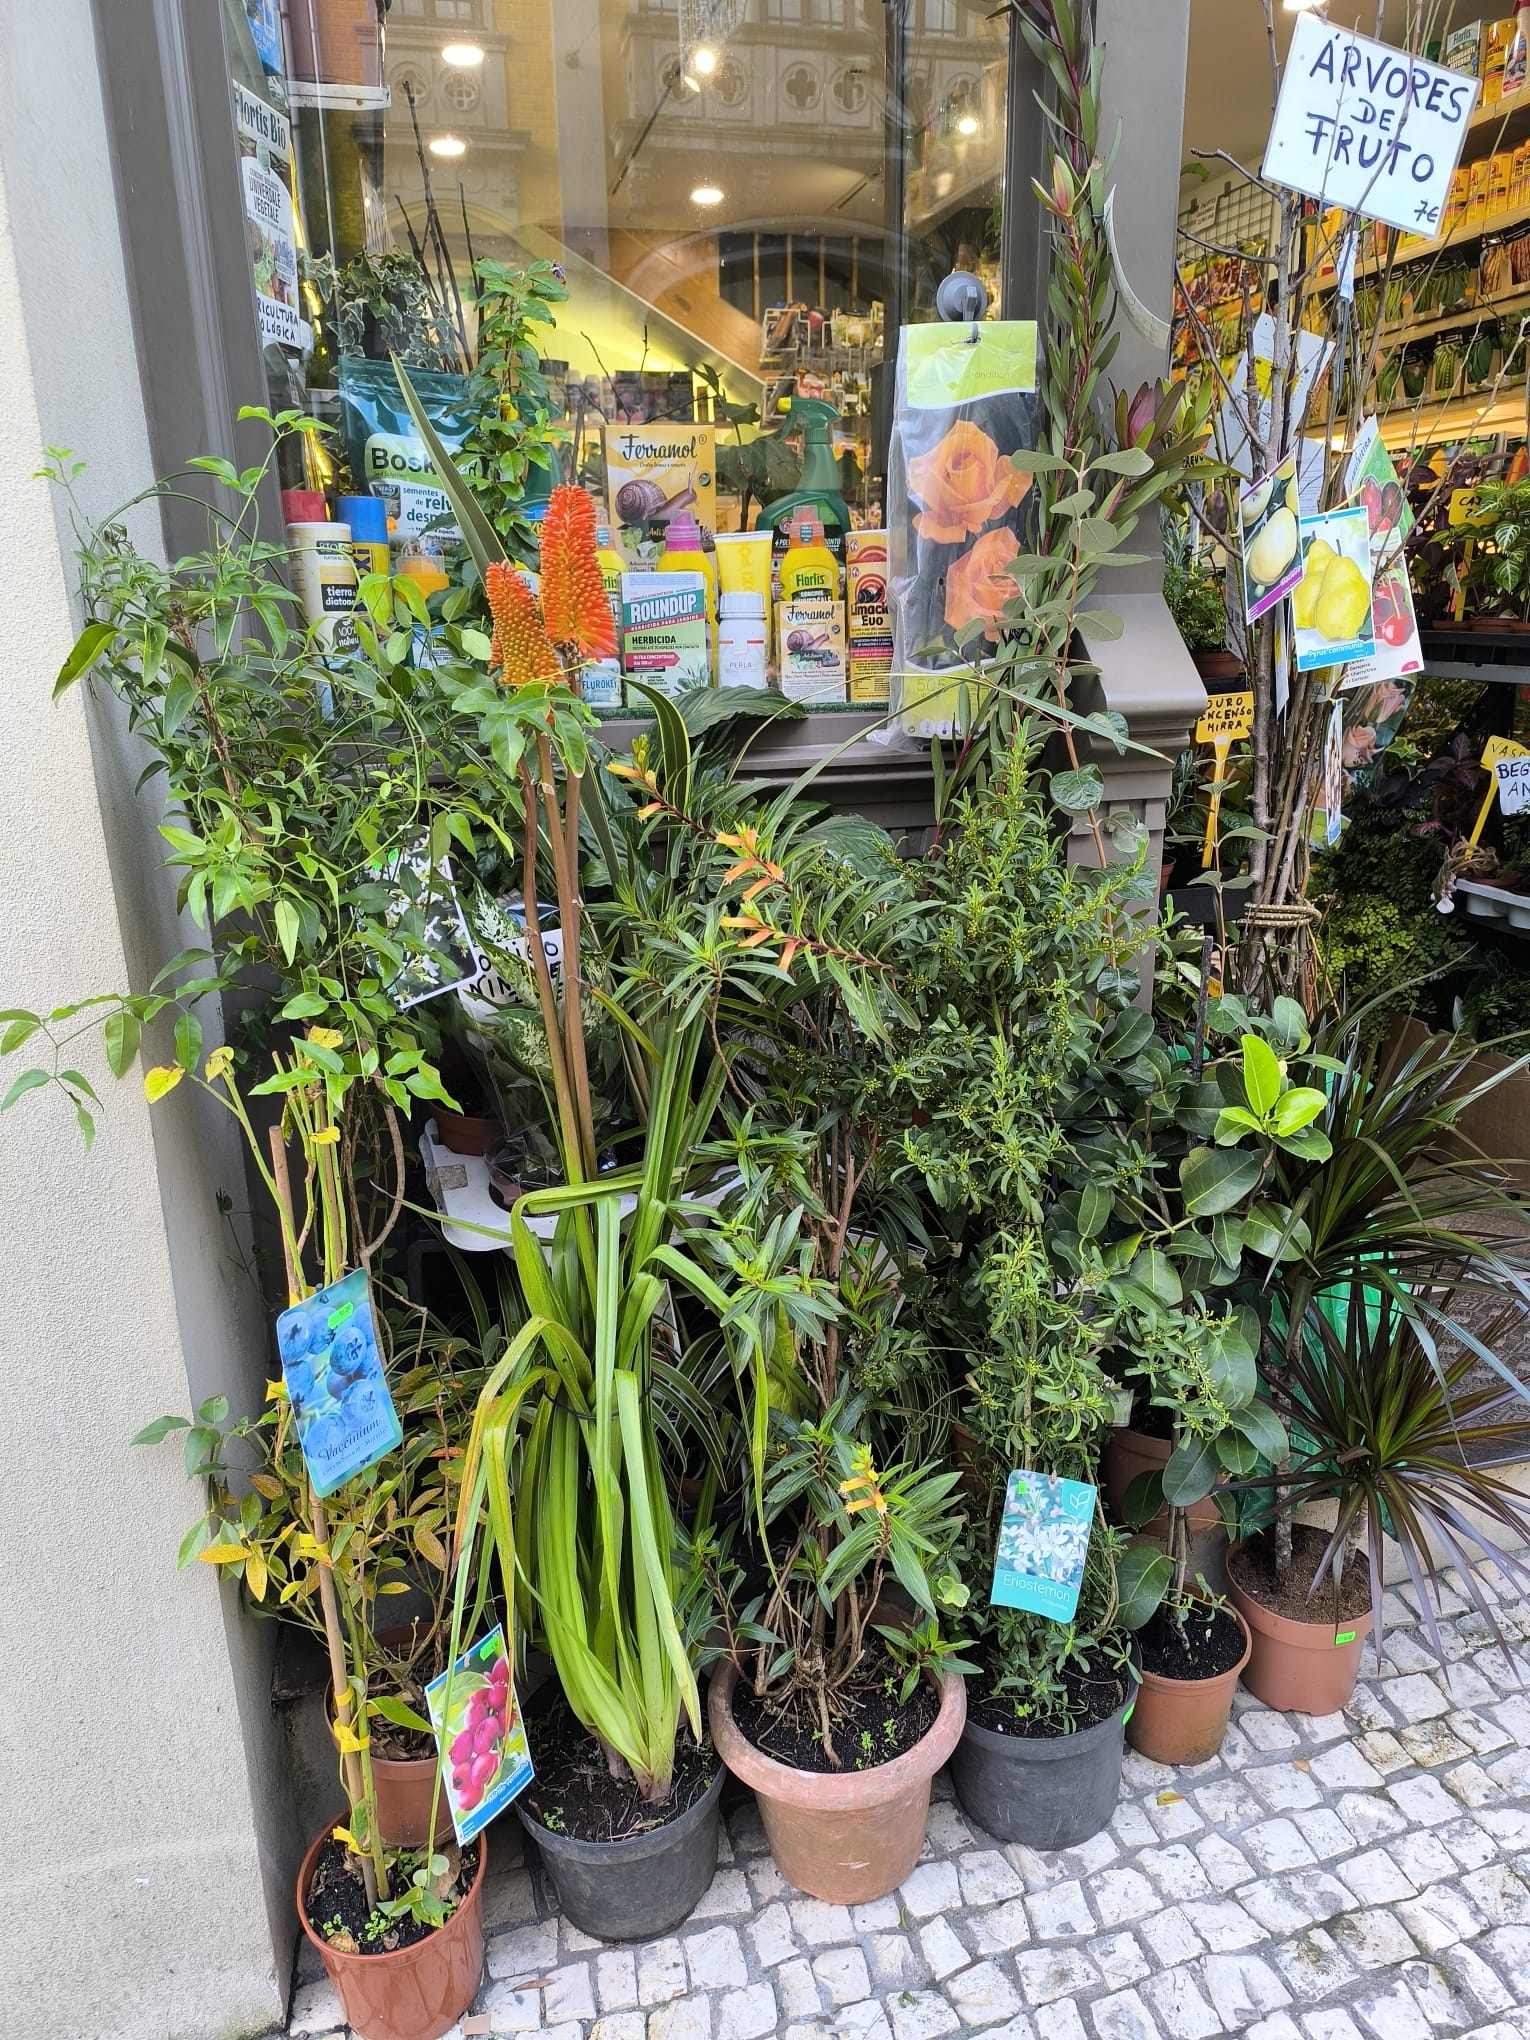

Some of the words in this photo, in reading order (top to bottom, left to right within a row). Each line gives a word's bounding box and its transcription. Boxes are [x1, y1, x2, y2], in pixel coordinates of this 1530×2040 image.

[1308, 33, 1470, 124] ÁRVORES
[1351, 97, 1395, 131] DE
[270, 112, 286, 150] Bio
[1305, 111, 1436, 183] FRUTO
[1413, 199, 1440, 224] 7€
[258, 297, 299, 326] RICULTURA
[620, 433, 698, 461] Ferramol
[371, 447, 438, 476] Bosk
[403, 487, 439, 497] sementes
[425, 496, 454, 511] relv
[795, 573, 825, 587] Flortis
[630, 593, 697, 624] ROUNDUP
[786, 604, 835, 622] Ferramol
[632, 635, 677, 645] HERBICIDA
[1308, 648, 1328, 660] Pyrus
[1327, 641, 1364, 654] communis
[729, 661, 752, 669] PERLA
[1496, 761, 1530, 779] BEG
[1507, 781, 1530, 796] AN
[318, 1417, 381, 1463] Vaccinium
[1003, 1574, 1071, 1603] Eriostemon
